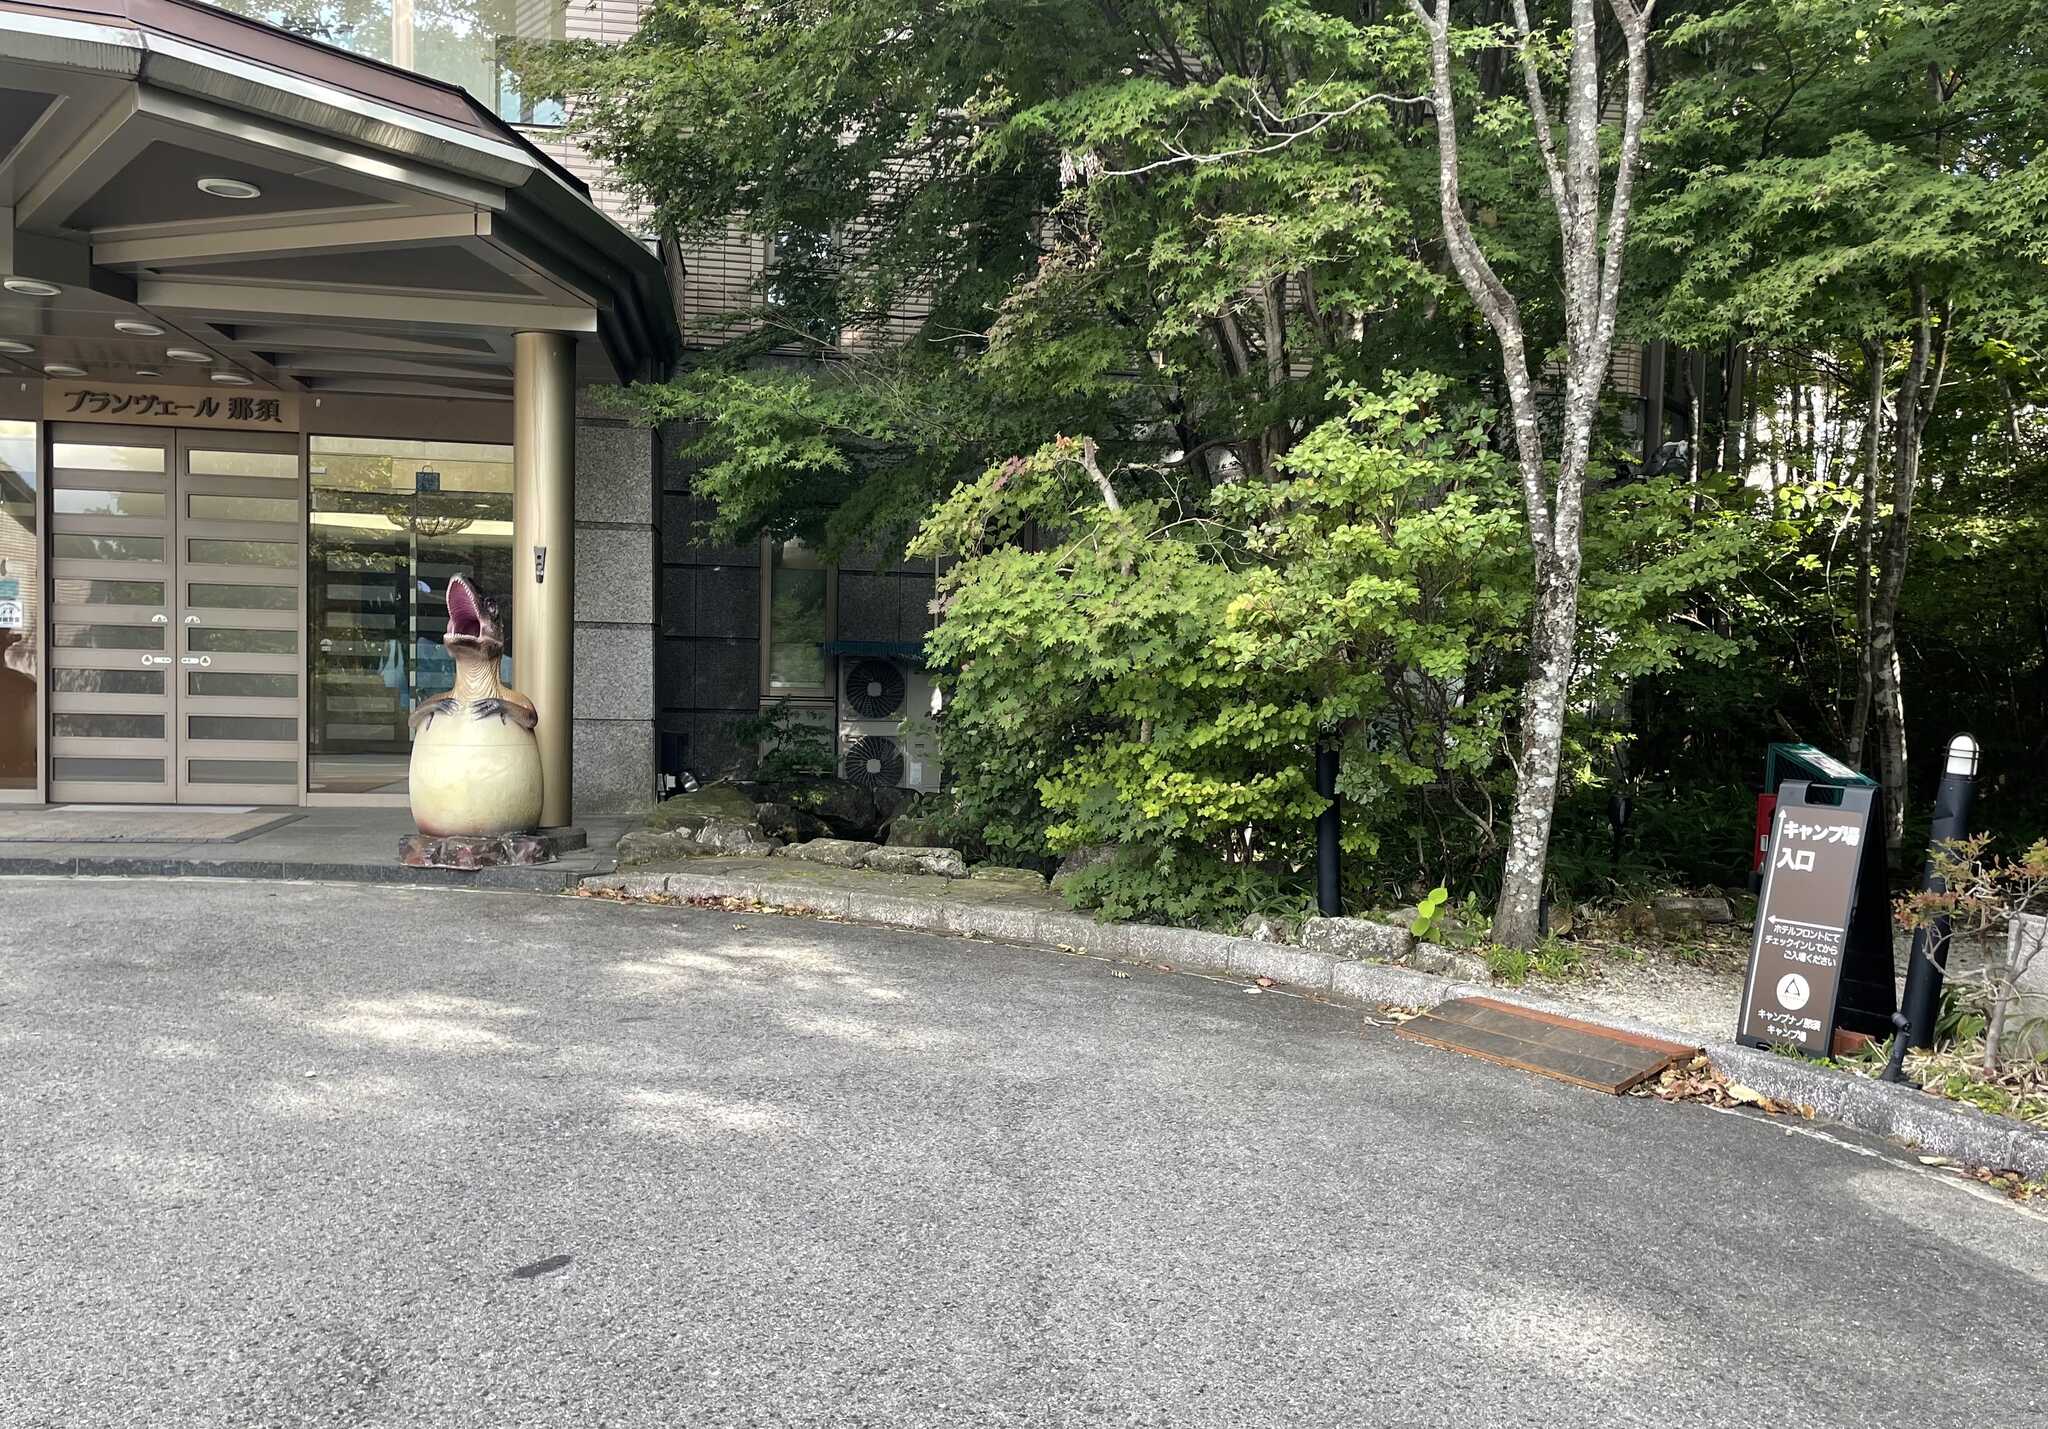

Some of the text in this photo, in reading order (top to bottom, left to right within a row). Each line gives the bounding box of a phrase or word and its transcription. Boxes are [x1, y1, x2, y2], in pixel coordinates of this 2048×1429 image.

[227, 397, 283, 423] 那須
[1783, 821, 1860, 846] キャンプ場
[1777, 847, 1816, 872] 入口
[1765, 935, 1838, 955] チェックインしてから
[1773, 924, 1841, 943] ホテルフロントにて
